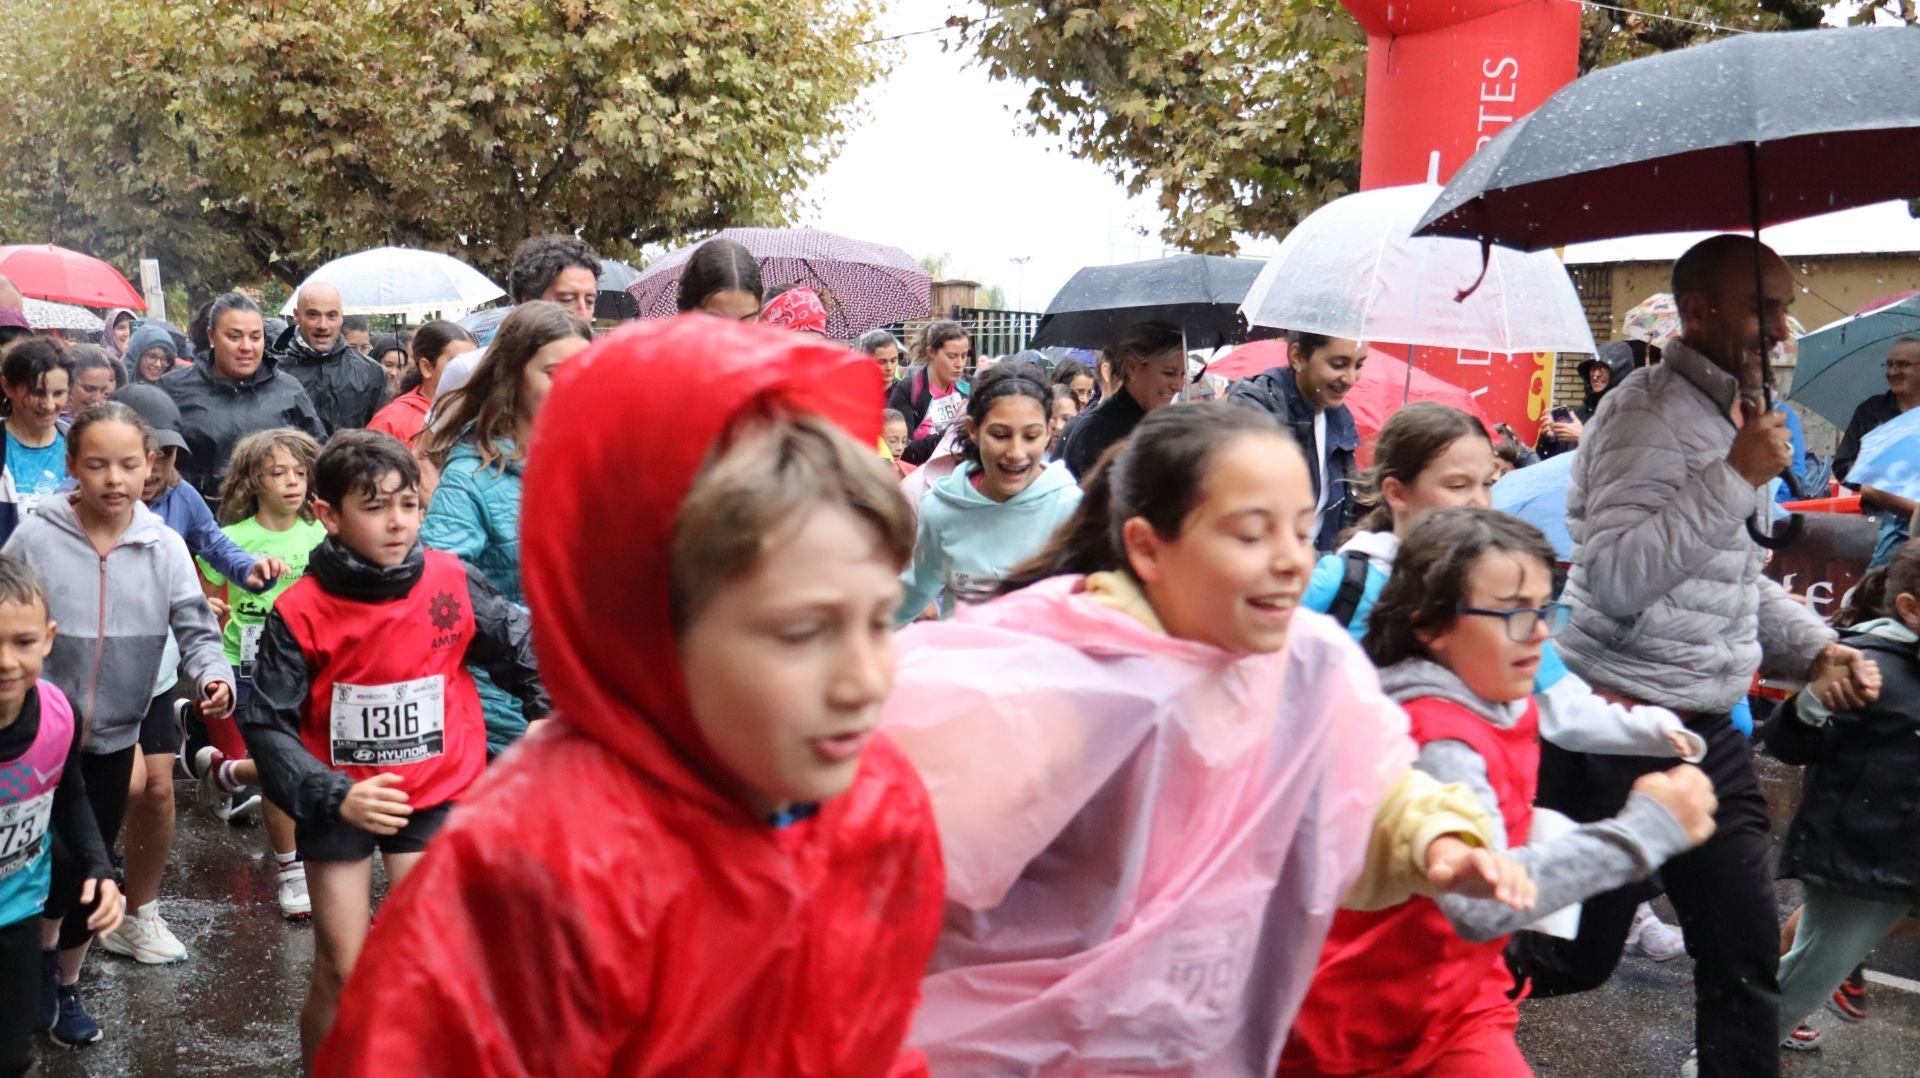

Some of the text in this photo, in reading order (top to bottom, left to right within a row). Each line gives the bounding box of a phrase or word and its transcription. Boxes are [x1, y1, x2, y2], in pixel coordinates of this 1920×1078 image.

[1476, 57, 1519, 152] TES
[937, 402, 963, 421] 361
[361, 702, 419, 738] 1316
[378, 744, 428, 760] HYUNDAI
